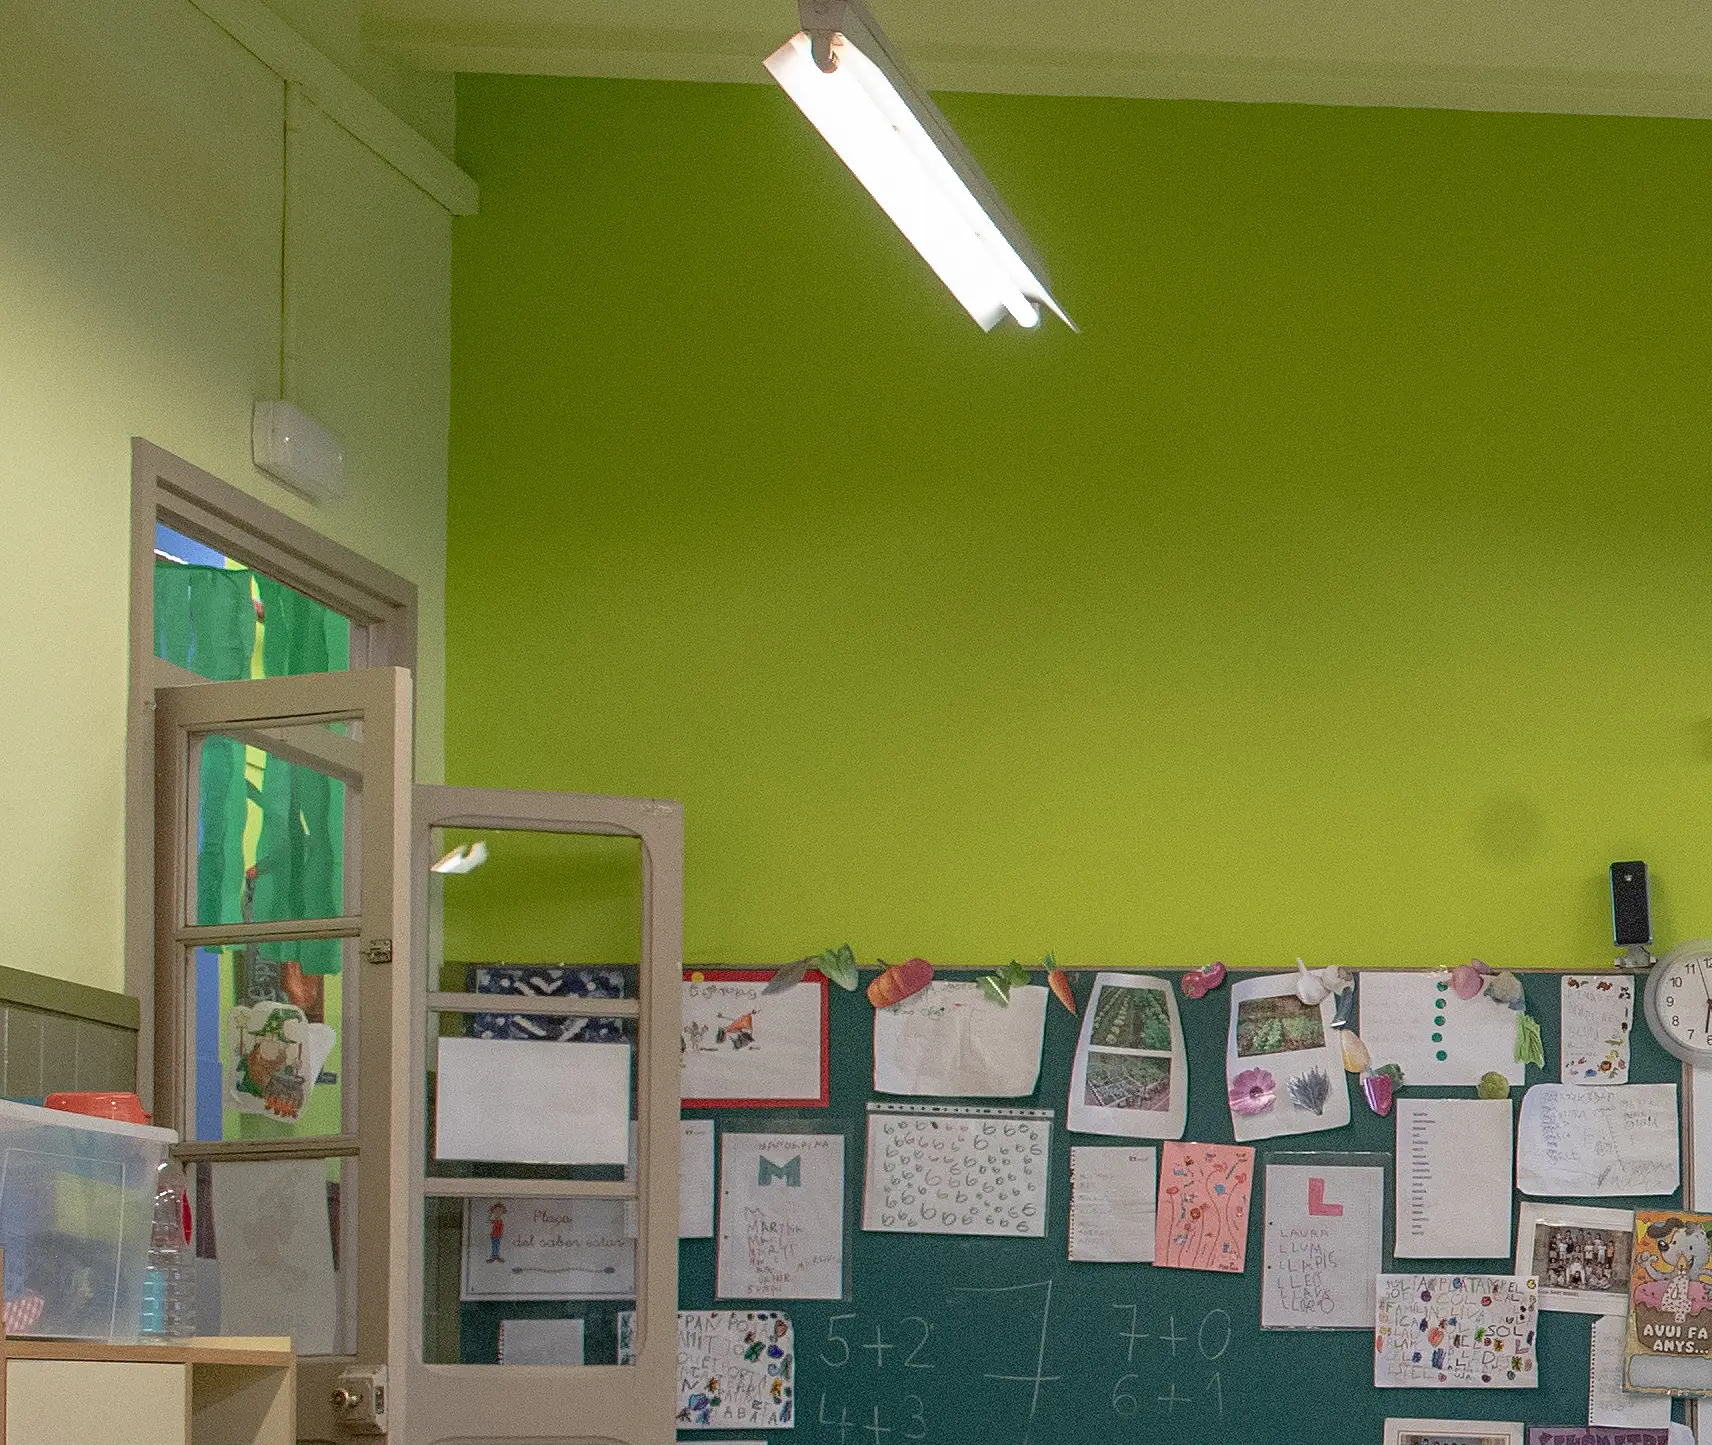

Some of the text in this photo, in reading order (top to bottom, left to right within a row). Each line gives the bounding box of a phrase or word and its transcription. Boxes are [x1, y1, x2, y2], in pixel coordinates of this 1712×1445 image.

[1684, 964, 1695, 974] 11
[1670, 977, 1682, 988] 10
[1666, 996, 1674, 1007] 9
[1672, 1015, 1680, 1026] 8
[1688, 1029, 1694, 1040] 7
[758, 1153, 801, 1187] M
[1308, 1177, 1344, 1217] L
[1280, 1229, 1330, 1238] LAURA
[512, 1235, 534, 1248] del
[1484, 1323, 1523, 1338] SOL
[1643, 1323, 1709, 1340] AVUI FA
